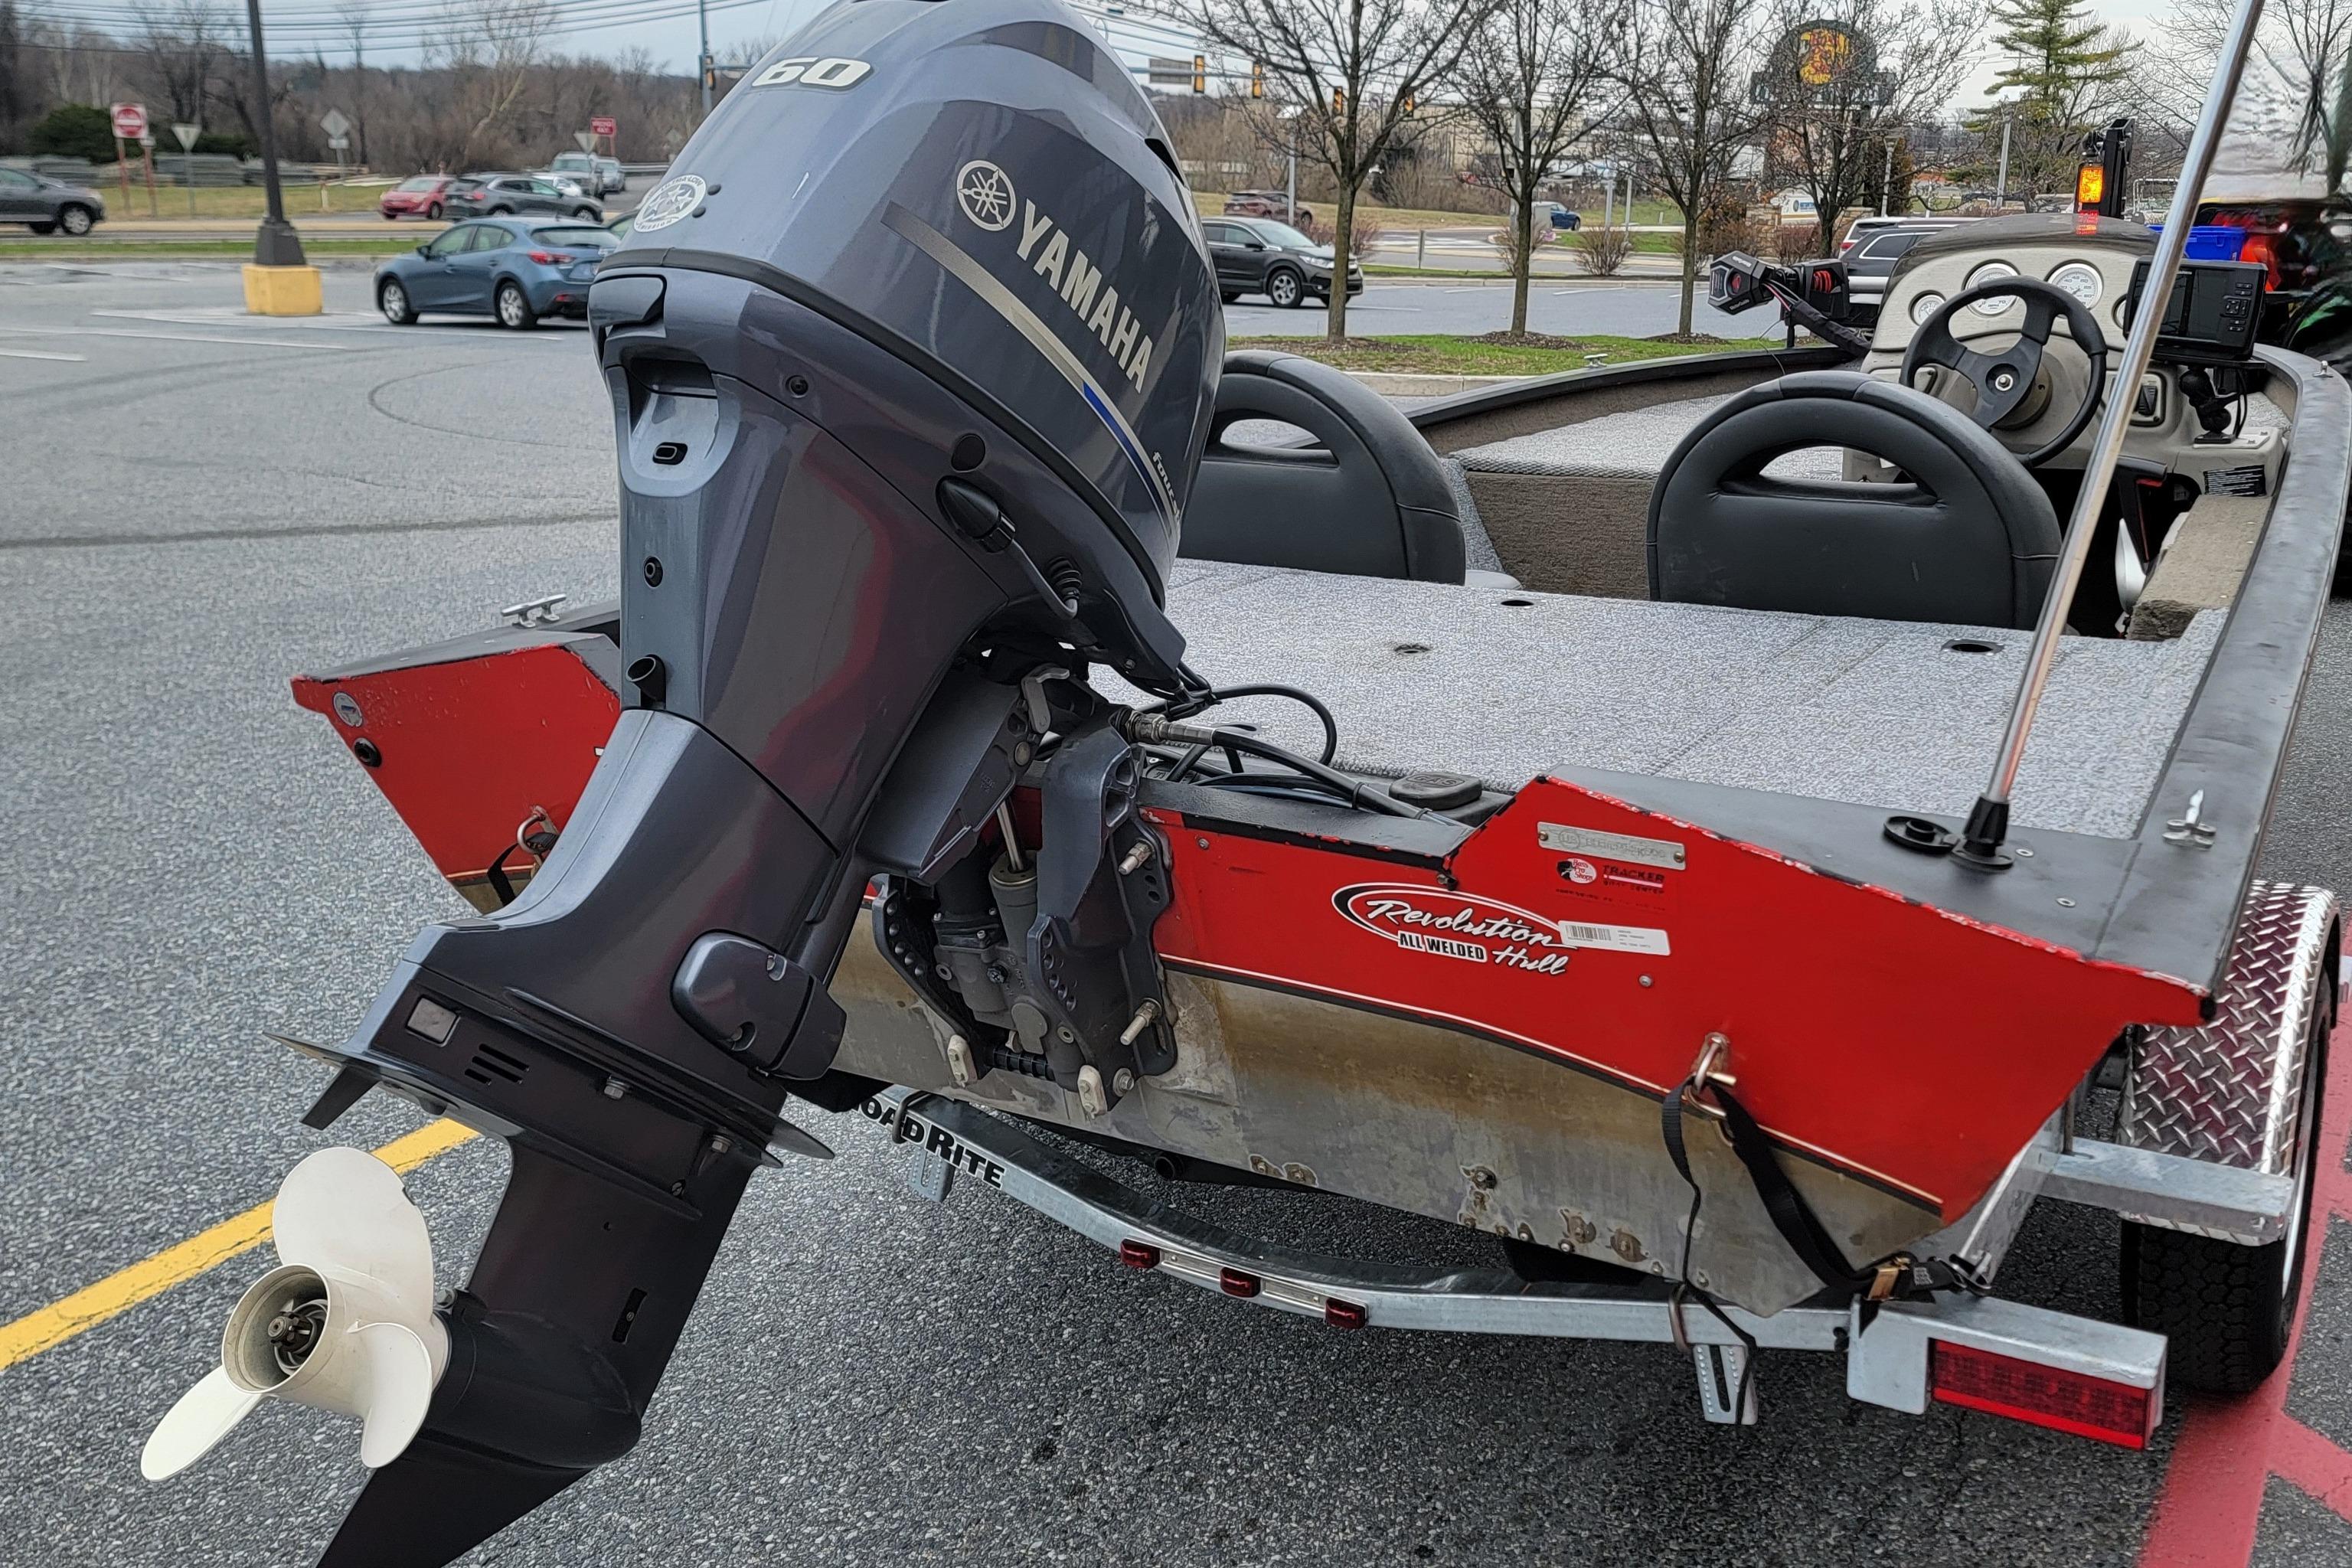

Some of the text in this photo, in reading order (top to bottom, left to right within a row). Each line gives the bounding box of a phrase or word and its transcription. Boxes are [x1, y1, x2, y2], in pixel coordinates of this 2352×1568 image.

[752, 57, 871, 87] 60
[1017, 198, 1152, 394] YAMAHA
[1413, 775, 1456, 786] GAS
[1602, 864, 1664, 883] TRACKER
[1367, 900, 1577, 949] Revolution
[1400, 933, 1485, 960] ALL WELDED
[1492, 946, 1569, 975] Hull
